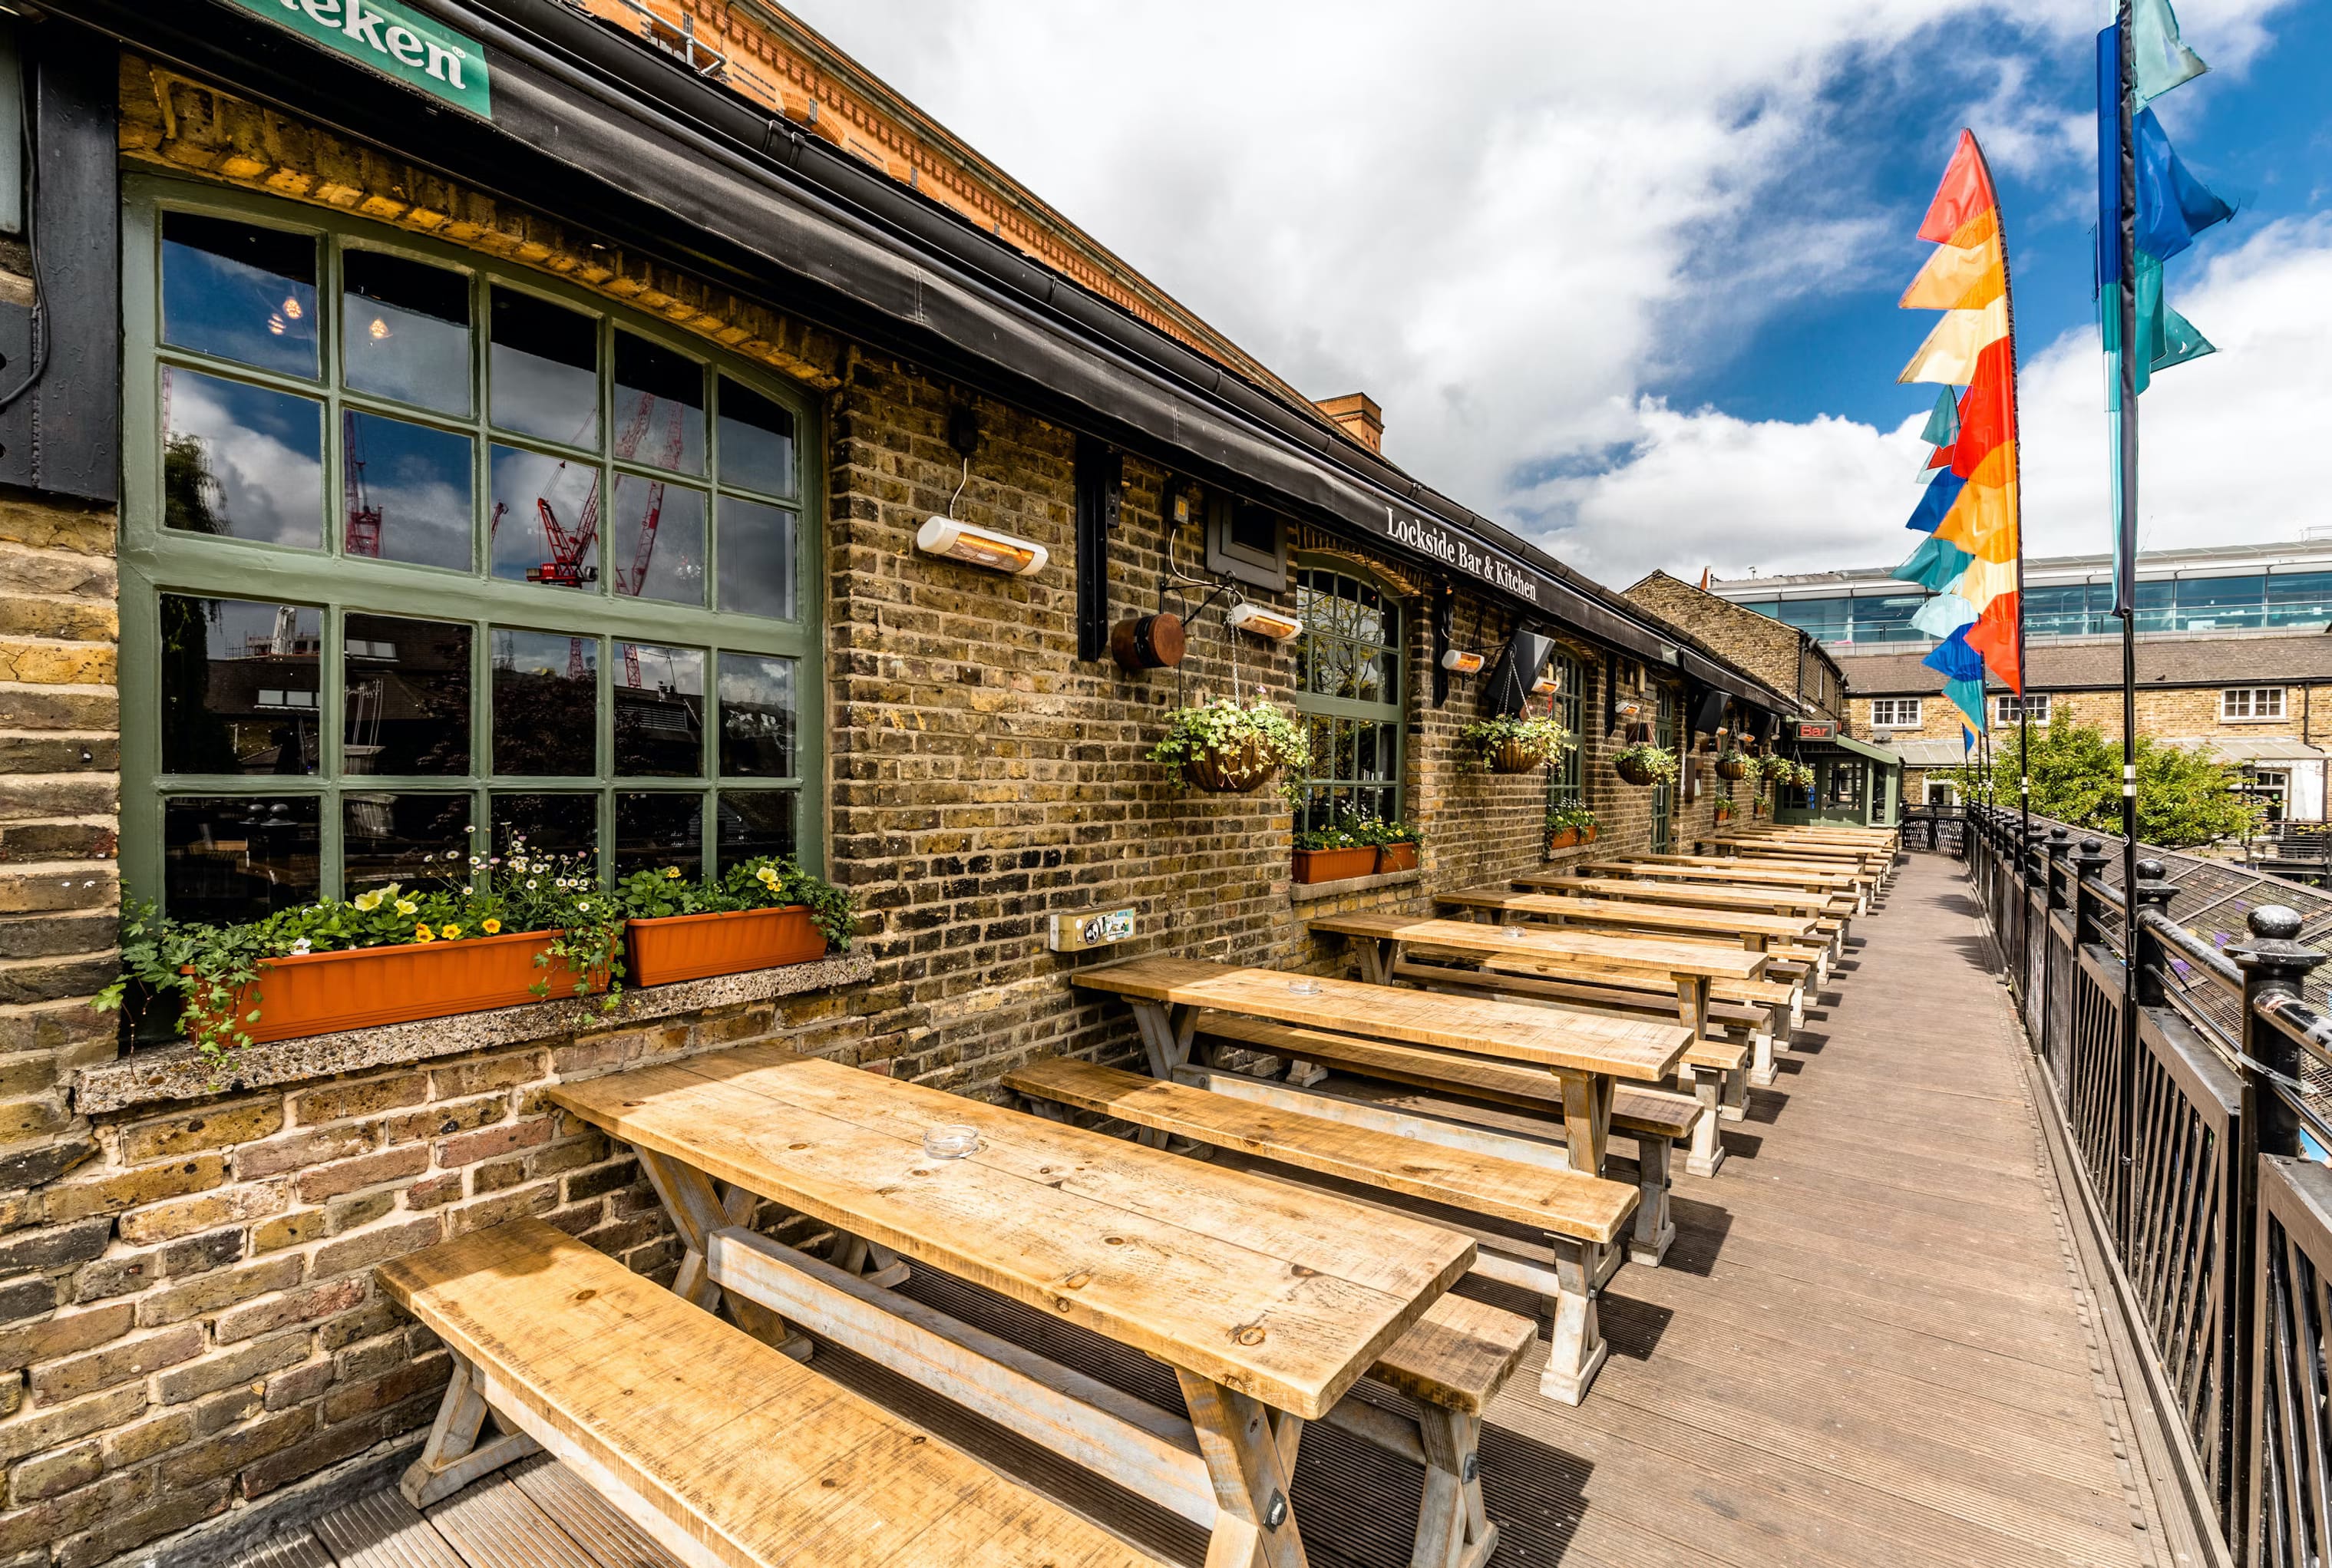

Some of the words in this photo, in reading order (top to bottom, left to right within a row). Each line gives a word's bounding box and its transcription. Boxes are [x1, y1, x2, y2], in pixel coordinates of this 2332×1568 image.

[281, 0, 466, 89] eken
[1386, 507, 1455, 563] Lockside
[1458, 541, 1481, 575] Bar
[1485, 555, 1495, 581] &
[1495, 560, 1537, 602] Kitchen
[1800, 725, 1828, 737] Bar
